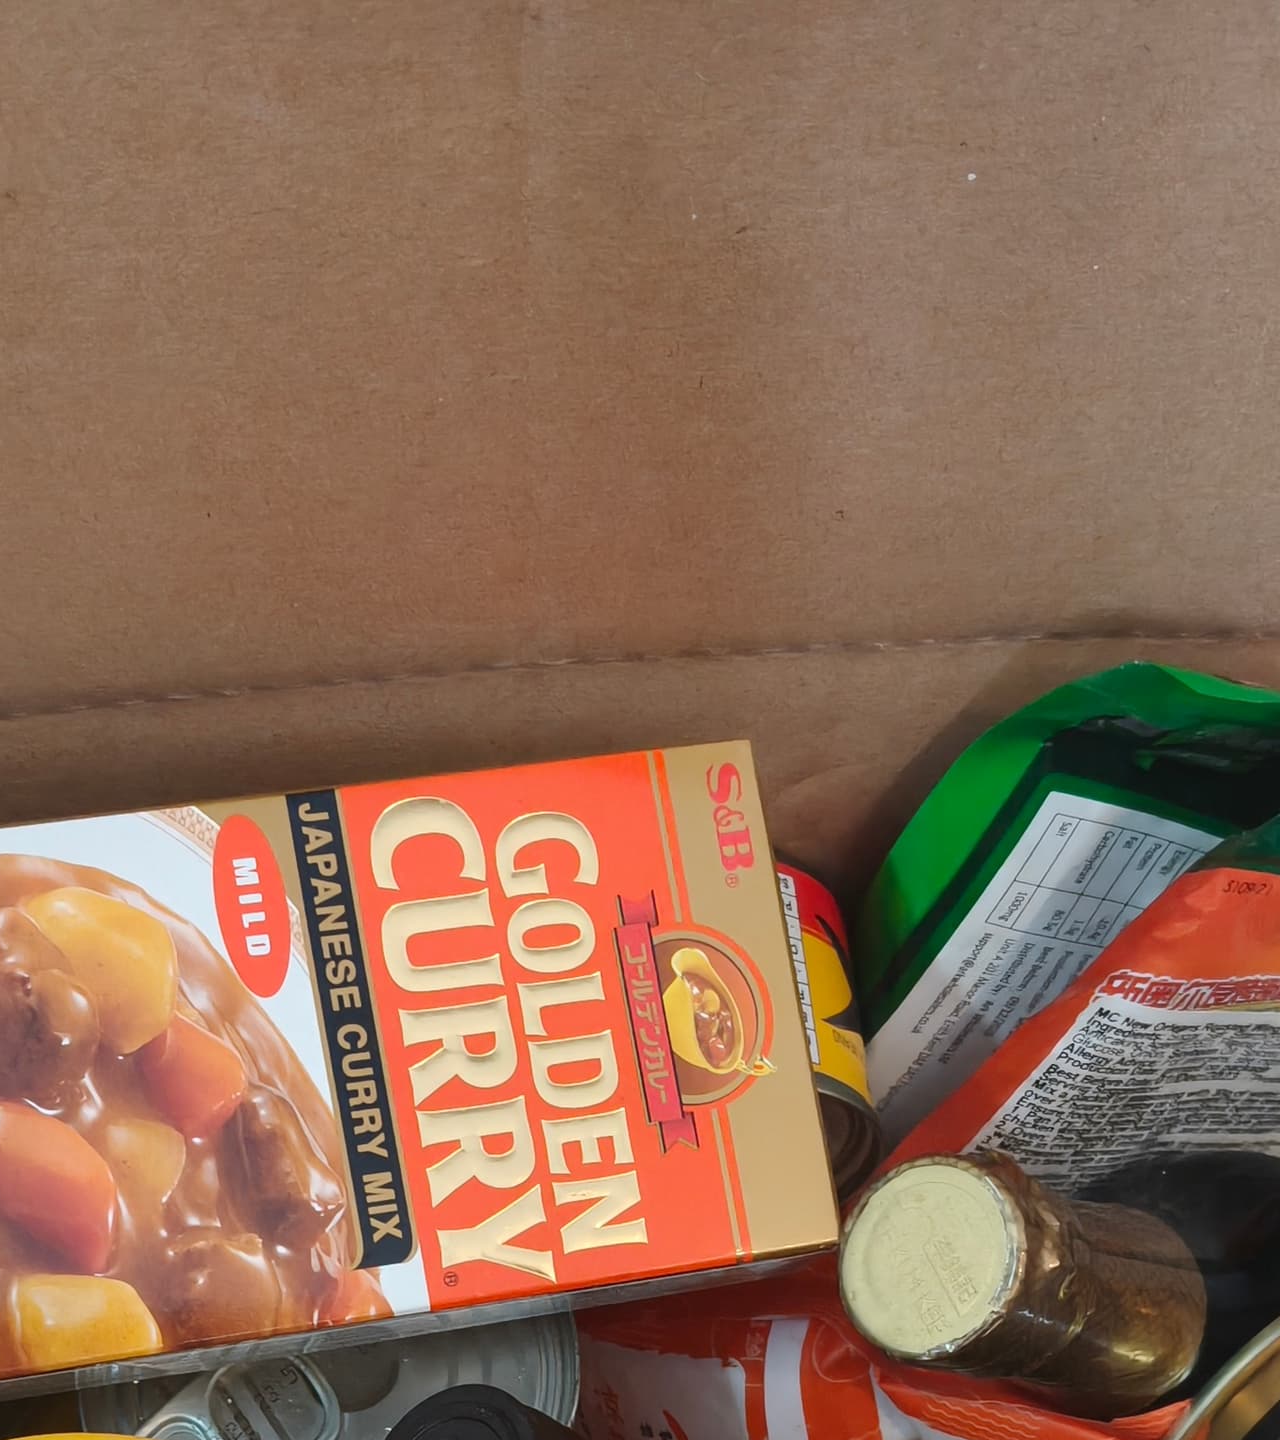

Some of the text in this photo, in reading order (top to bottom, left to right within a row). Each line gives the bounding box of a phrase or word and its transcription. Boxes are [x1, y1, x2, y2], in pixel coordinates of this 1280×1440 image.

[705, 762, 756, 872] S&B
[1056, 821, 1074, 838] Salt
[230, 856, 273, 958] MILD
[296, 802, 405, 1245] JAPANESE CURRY MIX
[370, 795, 556, 1284] CURRY
[494, 811, 648, 1254] GOLDEN
[1096, 1007, 1121, 1022] MC
